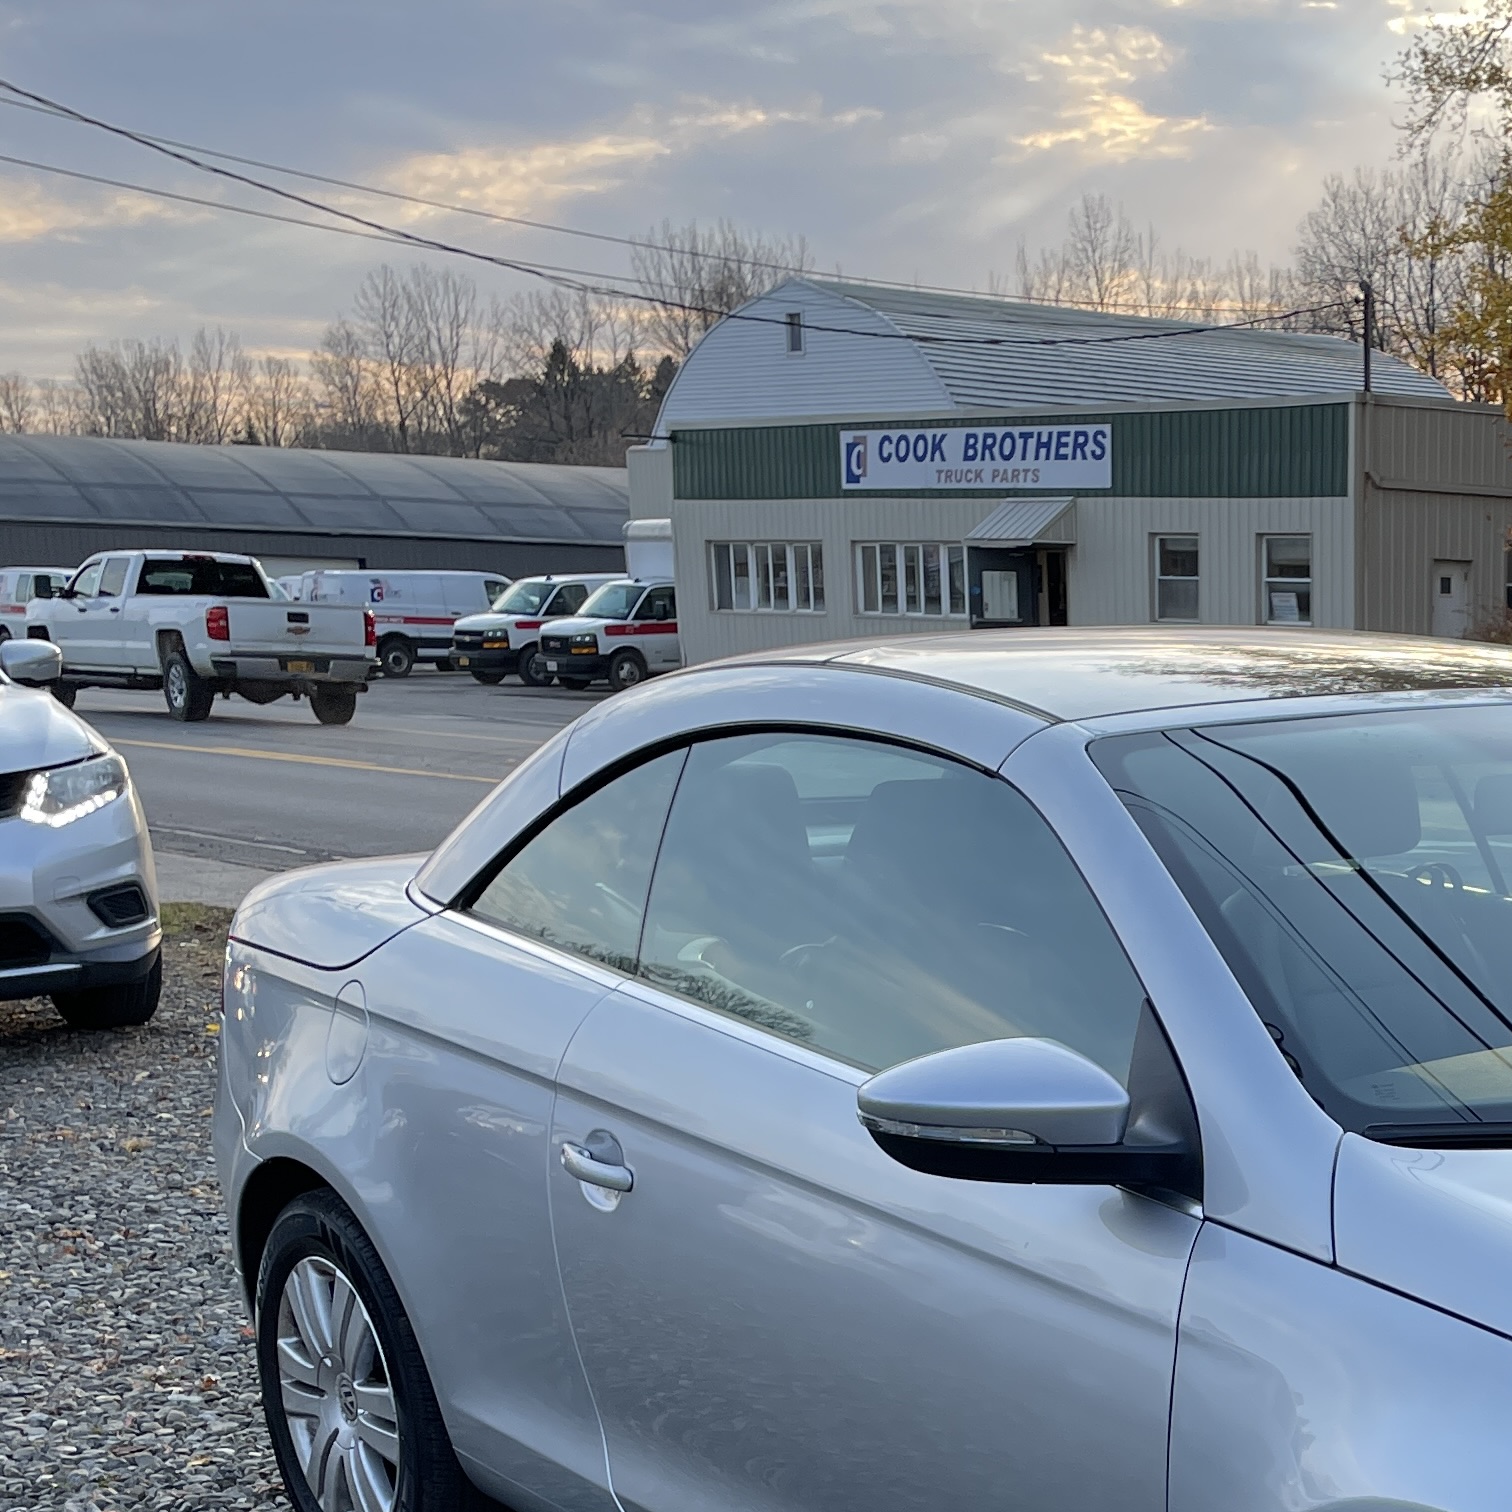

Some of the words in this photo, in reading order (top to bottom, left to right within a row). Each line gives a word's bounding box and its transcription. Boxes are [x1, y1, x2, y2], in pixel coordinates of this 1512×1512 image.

[878, 434, 948, 463] COOK
[962, 430, 1108, 462] BROTHERS
[936, 469, 983, 484] TRUCK
[991, 468, 1040, 483] PARTS
